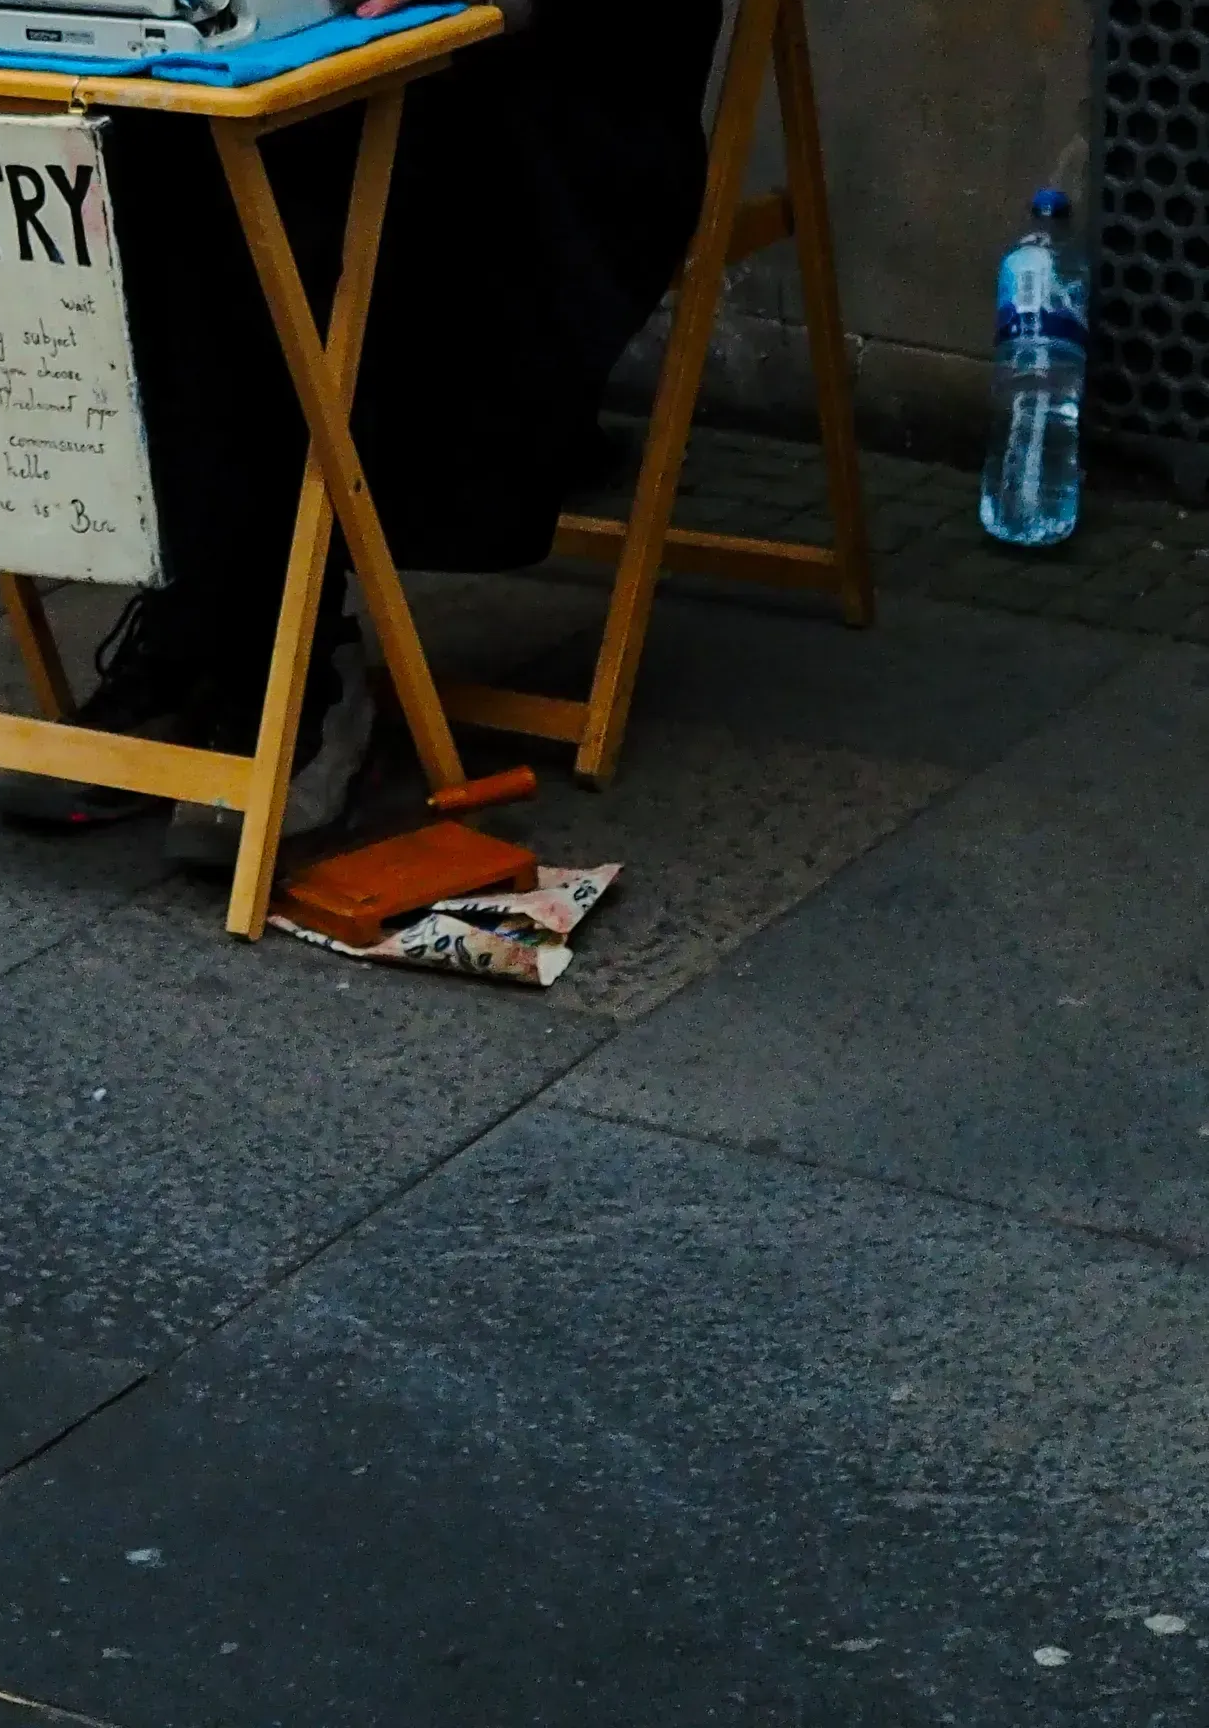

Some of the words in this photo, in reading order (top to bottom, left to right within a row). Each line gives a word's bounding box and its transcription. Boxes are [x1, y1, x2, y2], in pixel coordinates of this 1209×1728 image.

[61, 294, 96, 315] wait
[23, 318, 77, 359] subject
[0, 363, 26, 391] you
[37, 359, 83, 381] choose
[86, 406, 119, 430] paper
[4, 452, 51, 480] hello
[34, 504, 50, 519] is
